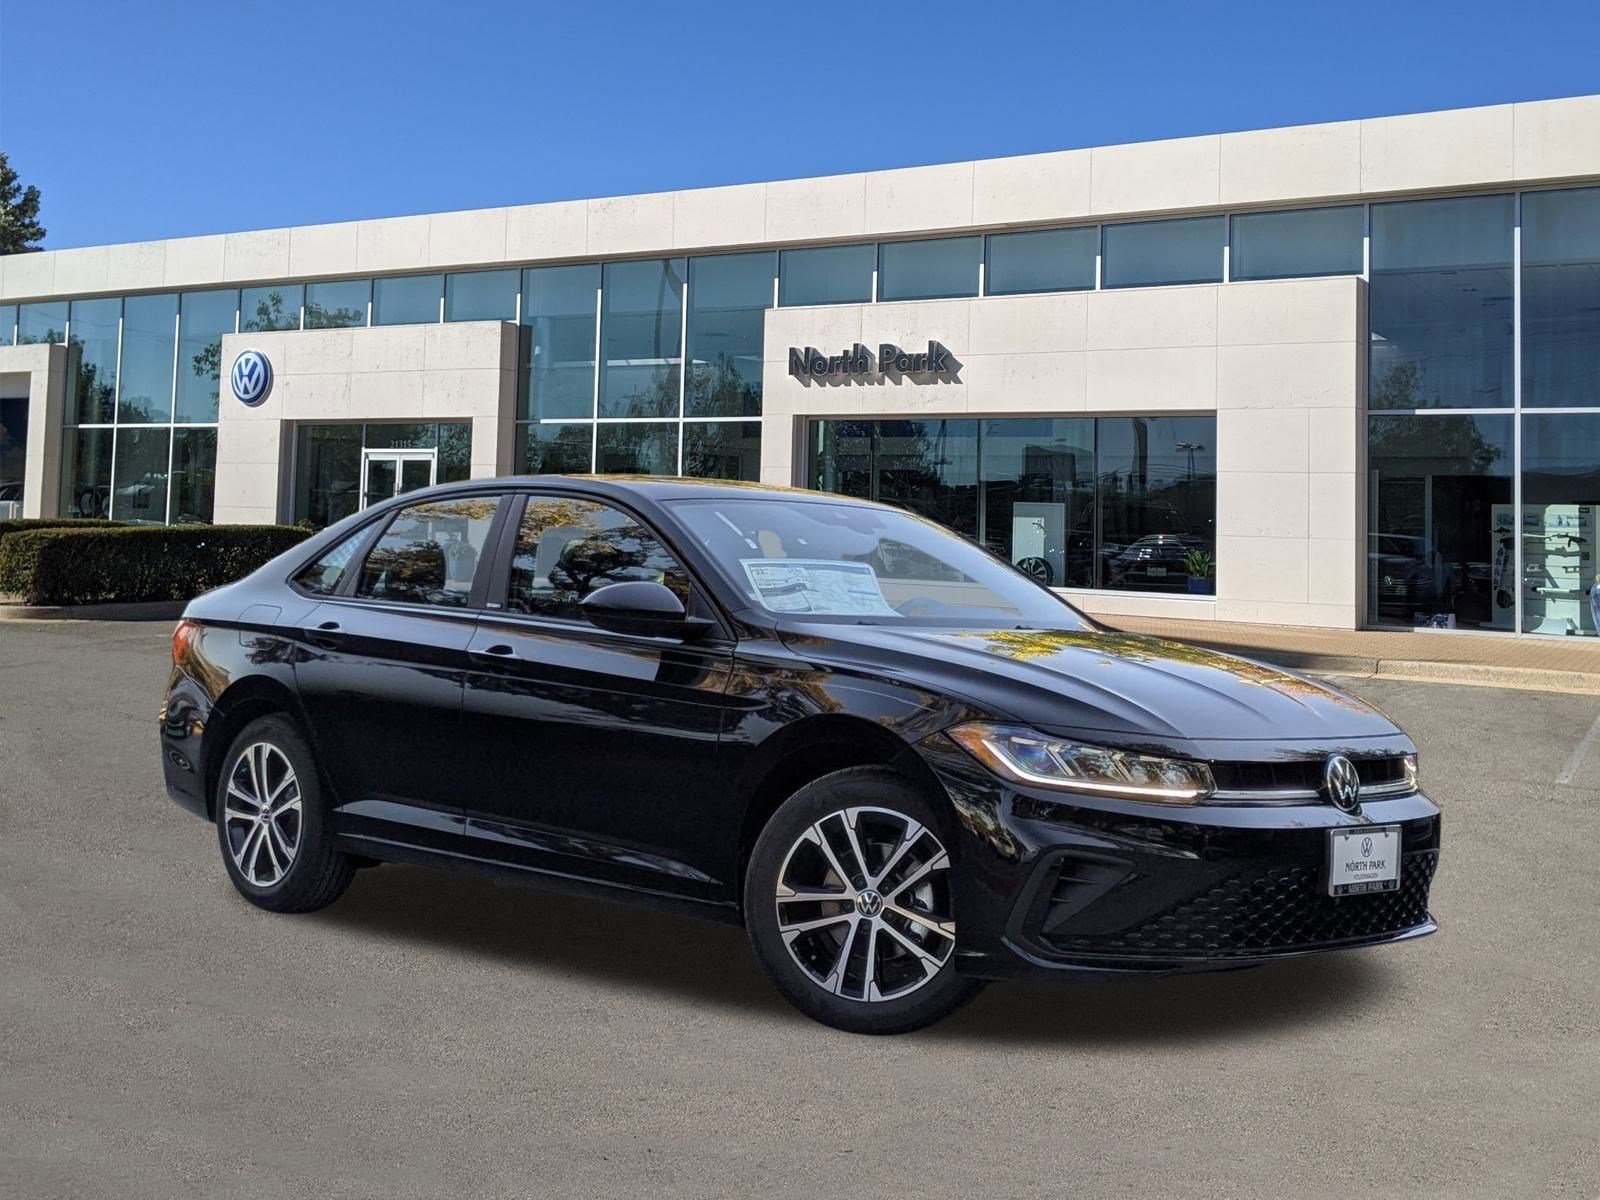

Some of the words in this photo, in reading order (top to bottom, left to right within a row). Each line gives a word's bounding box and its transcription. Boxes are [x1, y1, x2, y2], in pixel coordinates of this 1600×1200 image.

[789, 343, 870, 375] North
[879, 340, 947, 373] Park
[1345, 860, 1368, 872] NORTH
[1369, 859, 1386, 870] PARK
